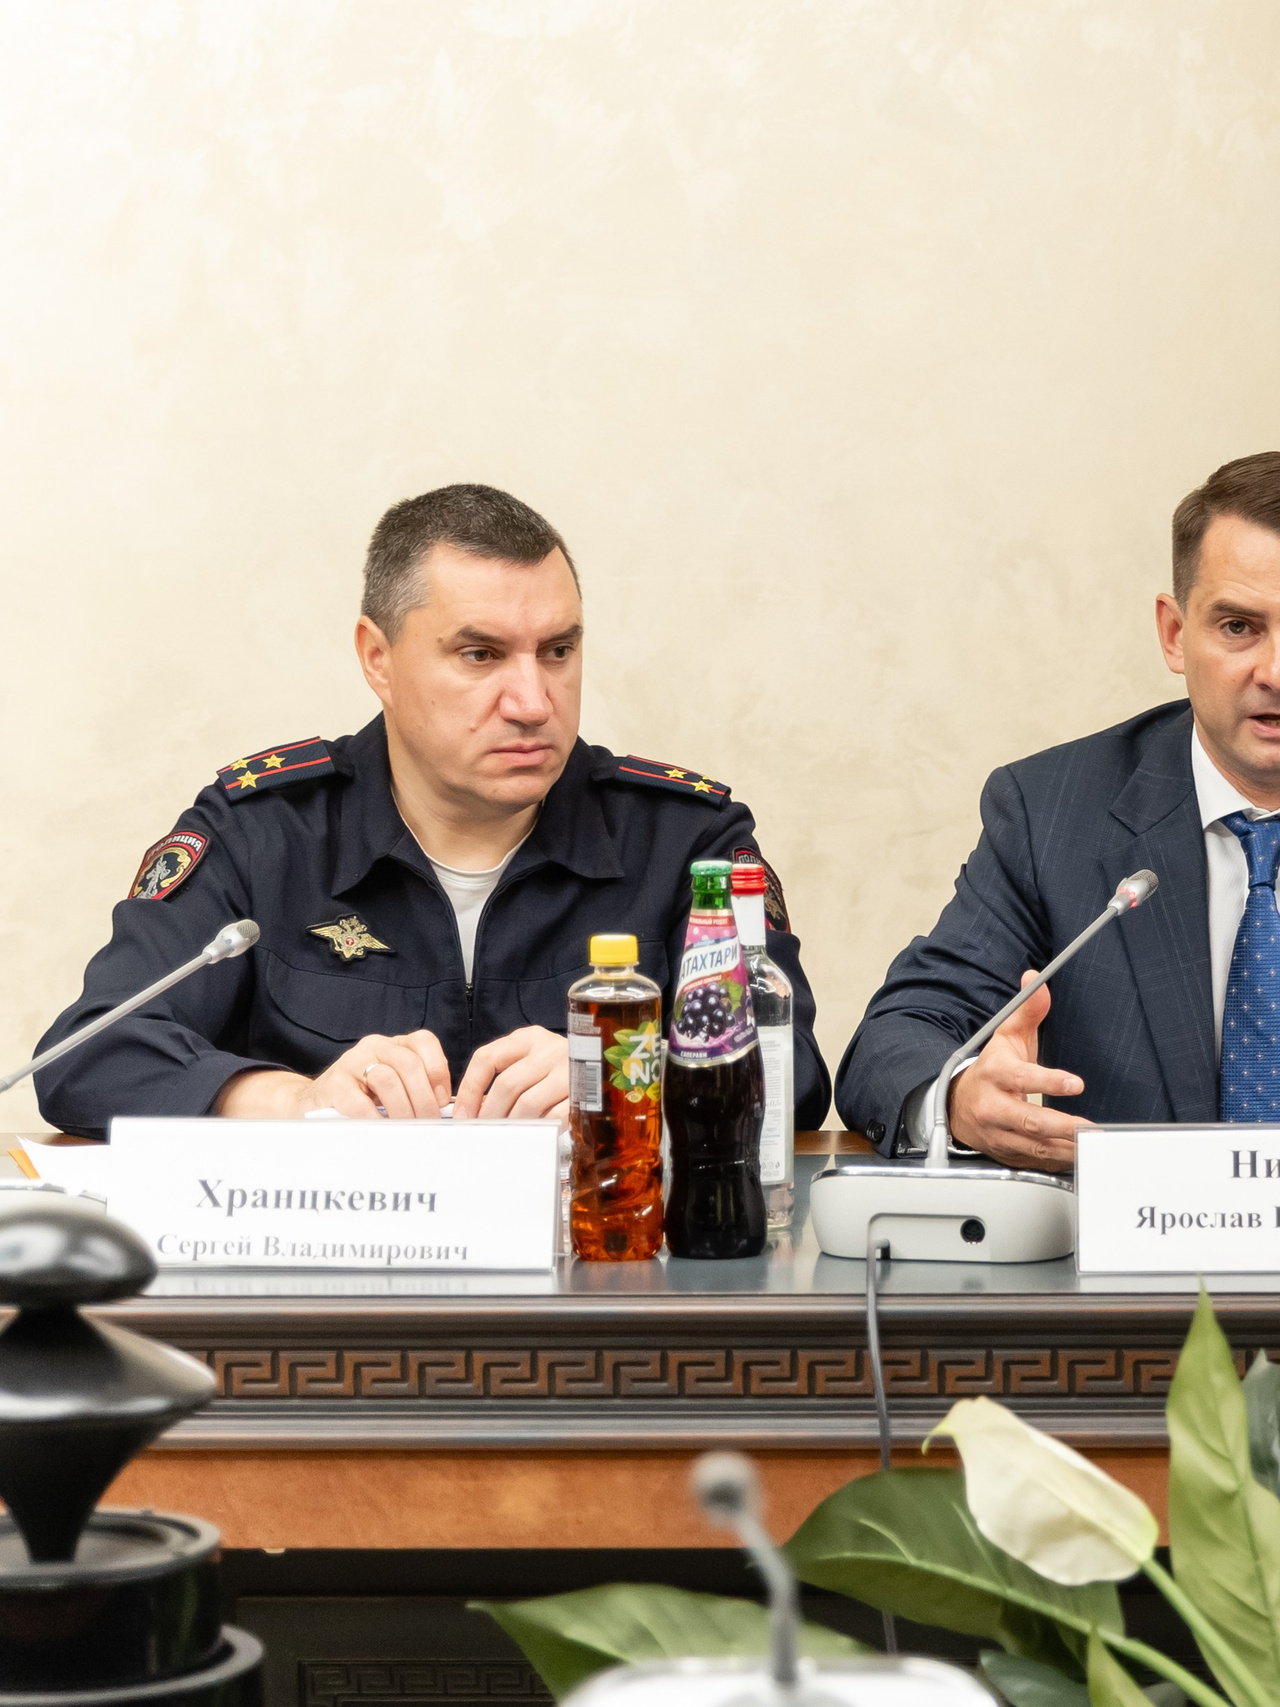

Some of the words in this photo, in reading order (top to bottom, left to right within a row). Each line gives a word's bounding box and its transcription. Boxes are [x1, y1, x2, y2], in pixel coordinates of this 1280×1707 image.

[680, 943, 738, 980] АТАХТАРИ
[196, 1178, 438, 1217] Хранцкевич
[1135, 1205, 1263, 1235] Ярослав
[156, 1233, 252, 1261] Сергей
[263, 1236, 469, 1265] Владимирович
